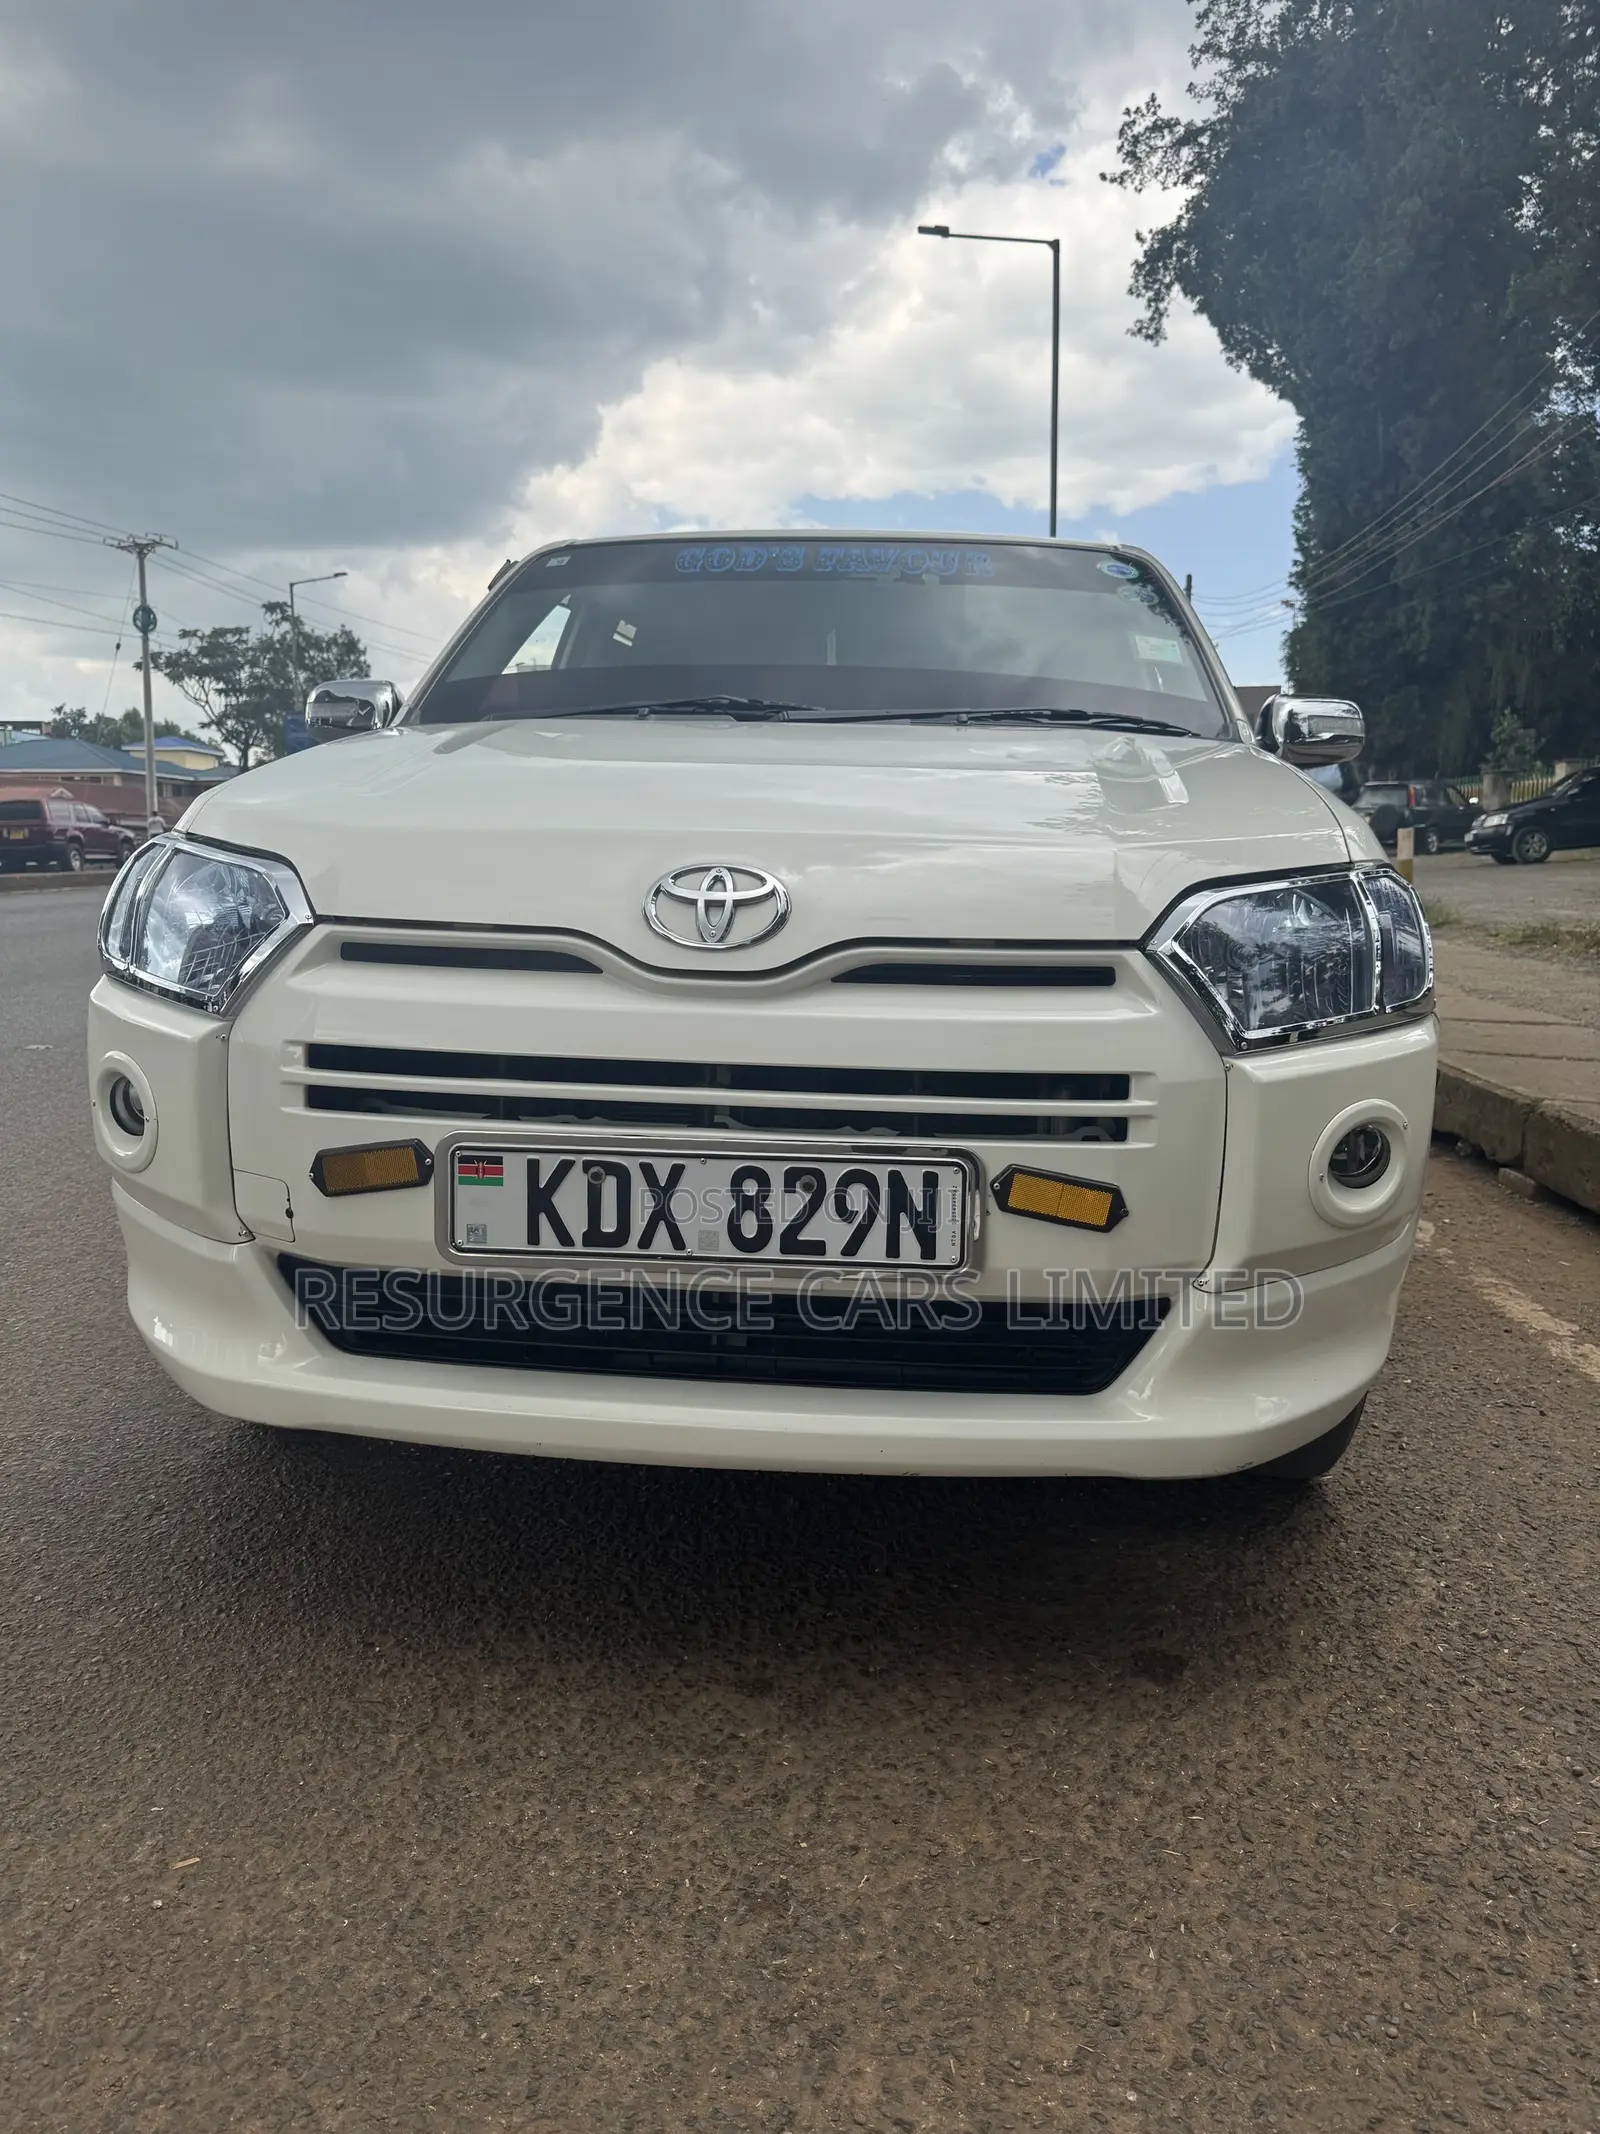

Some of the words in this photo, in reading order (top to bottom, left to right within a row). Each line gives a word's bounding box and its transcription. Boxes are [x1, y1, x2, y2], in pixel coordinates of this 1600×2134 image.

[674, 547, 804, 572] GOD'S
[813, 548, 994, 576] FAVOUR
[526, 1157, 686, 1250] KDX
[726, 1164, 939, 1260] 829N
